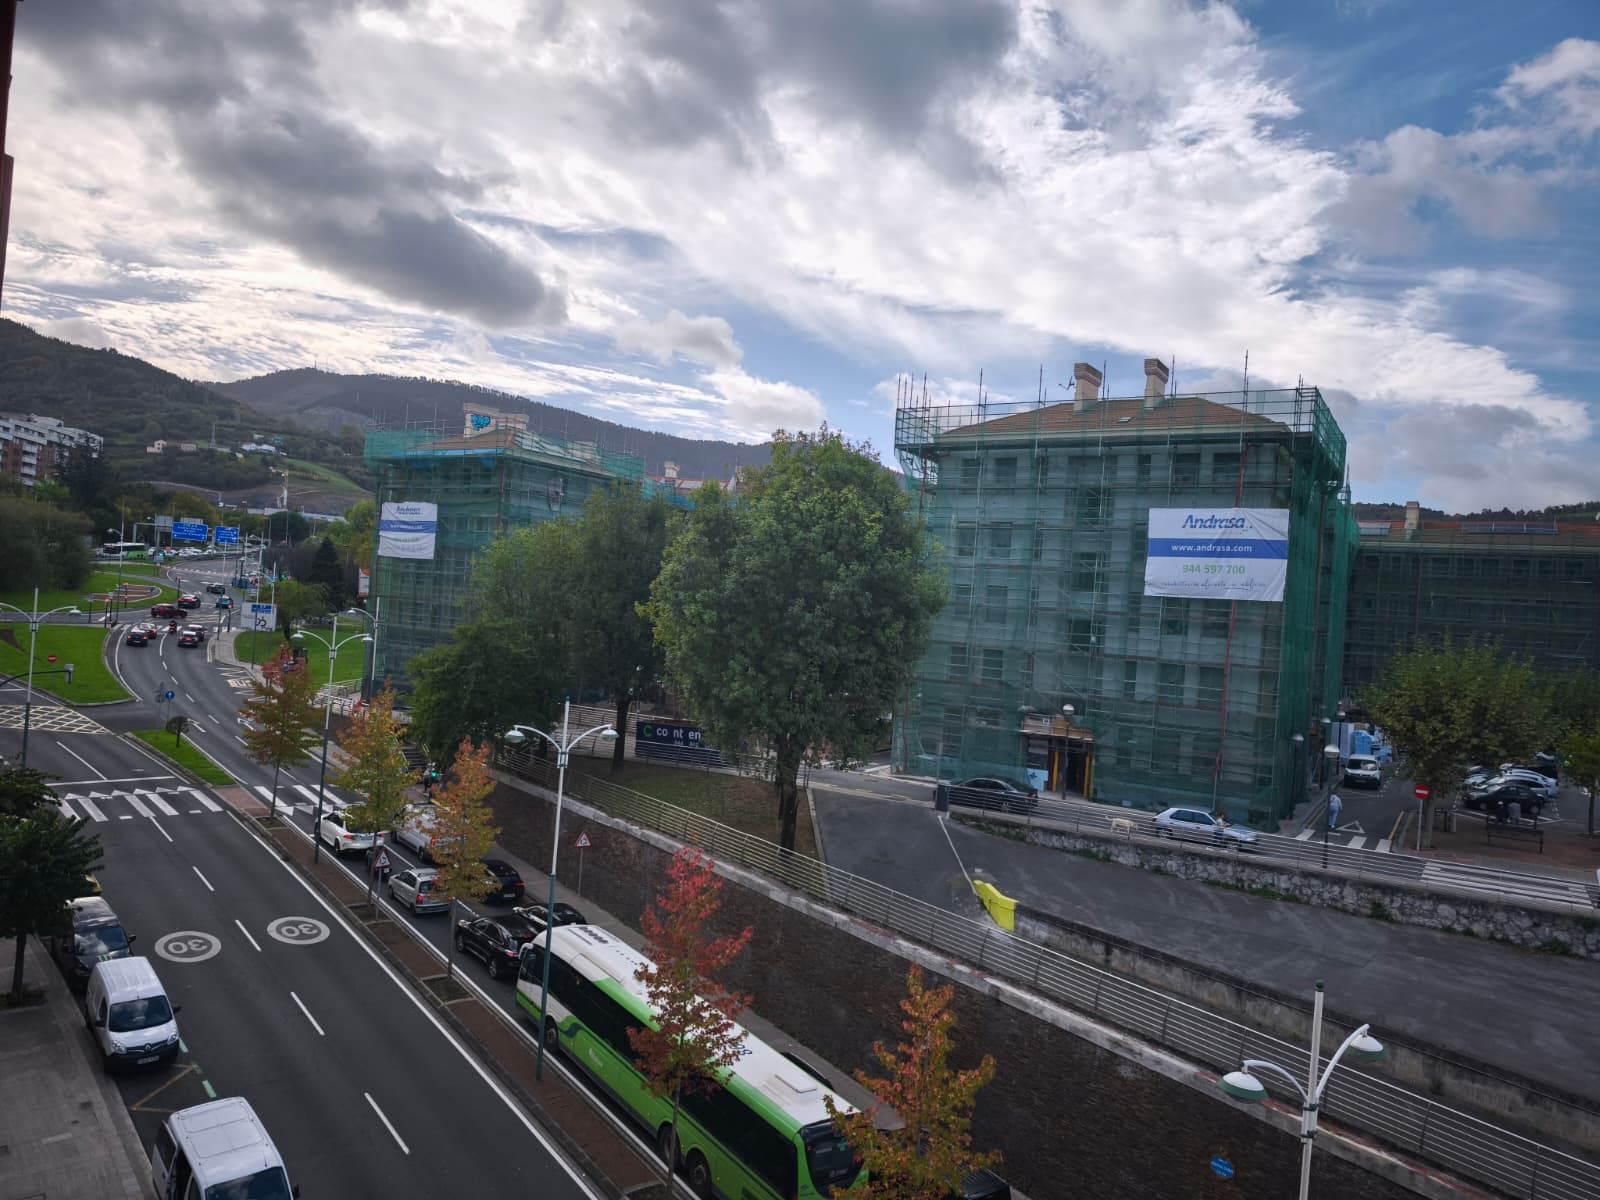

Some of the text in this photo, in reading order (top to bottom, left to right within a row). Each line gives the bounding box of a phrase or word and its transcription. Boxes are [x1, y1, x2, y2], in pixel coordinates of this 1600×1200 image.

[1182, 514, 1245, 529] Andrasa
[1171, 544, 1253, 553] www.andrasa.com
[1182, 564, 1245, 574] 944 597 700
[281, 923, 318, 938] 30
[167, 938, 208, 954] 30
